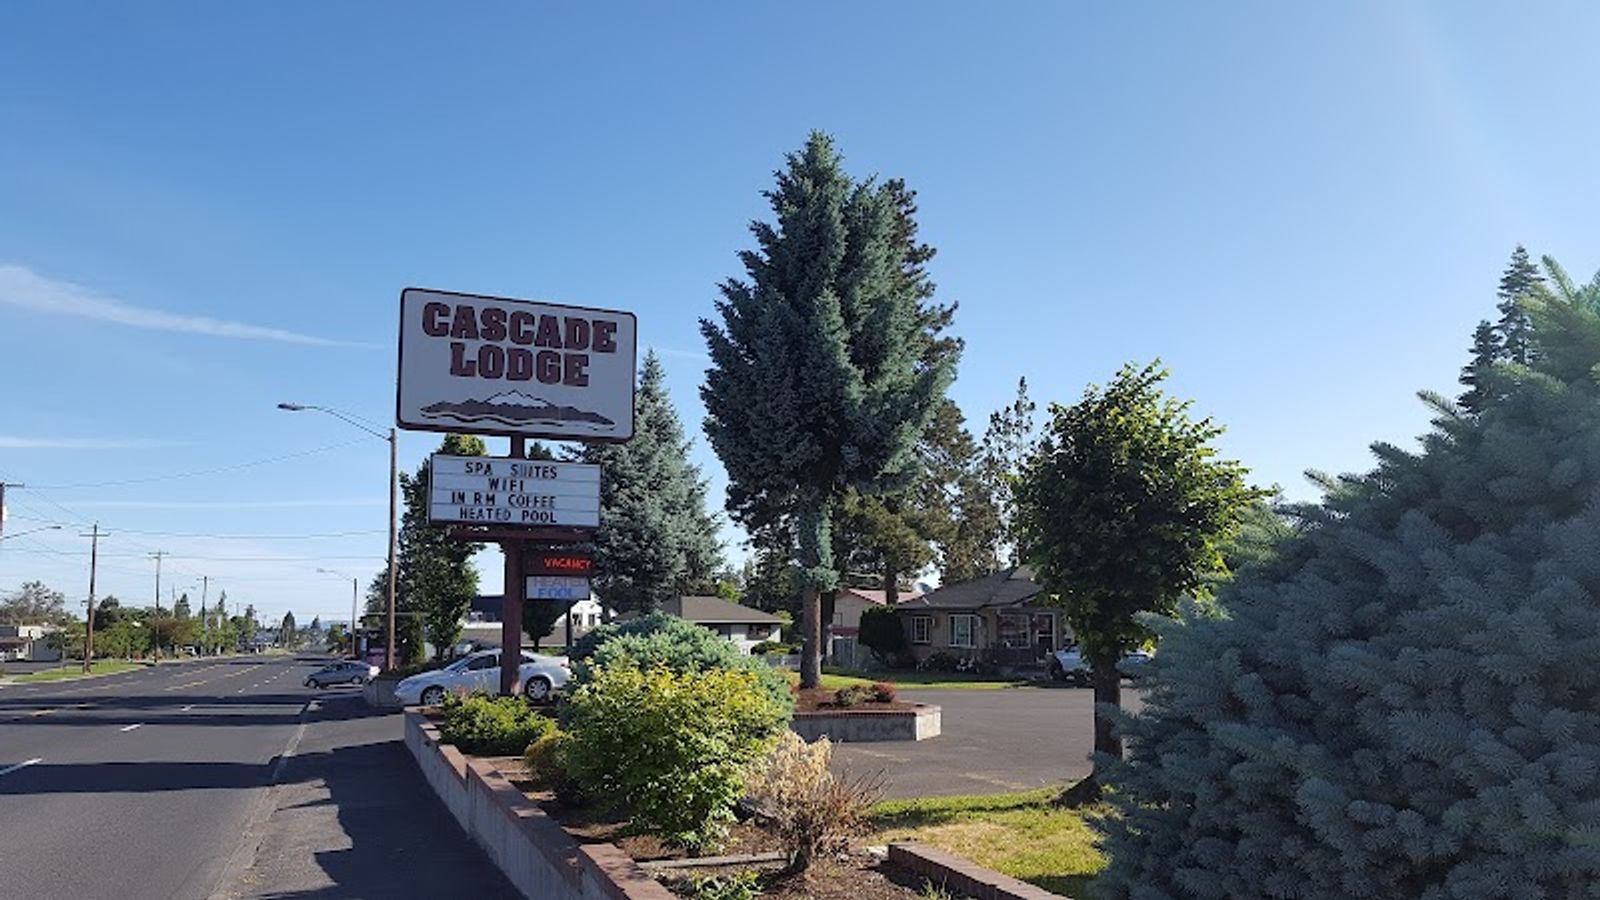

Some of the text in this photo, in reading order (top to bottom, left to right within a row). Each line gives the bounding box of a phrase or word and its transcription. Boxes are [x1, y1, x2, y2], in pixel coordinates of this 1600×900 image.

[422, 302, 617, 353] CASCADE
[450, 342, 589, 387] LODGE
[465, 461, 557, 479] SPA SUITES
[489, 478, 524, 491] WIFI
[452, 491, 557, 508] IN RM COFFEE
[460, 507, 557, 523] HEATED POOL
[544, 557, 591, 569] VACANCY
